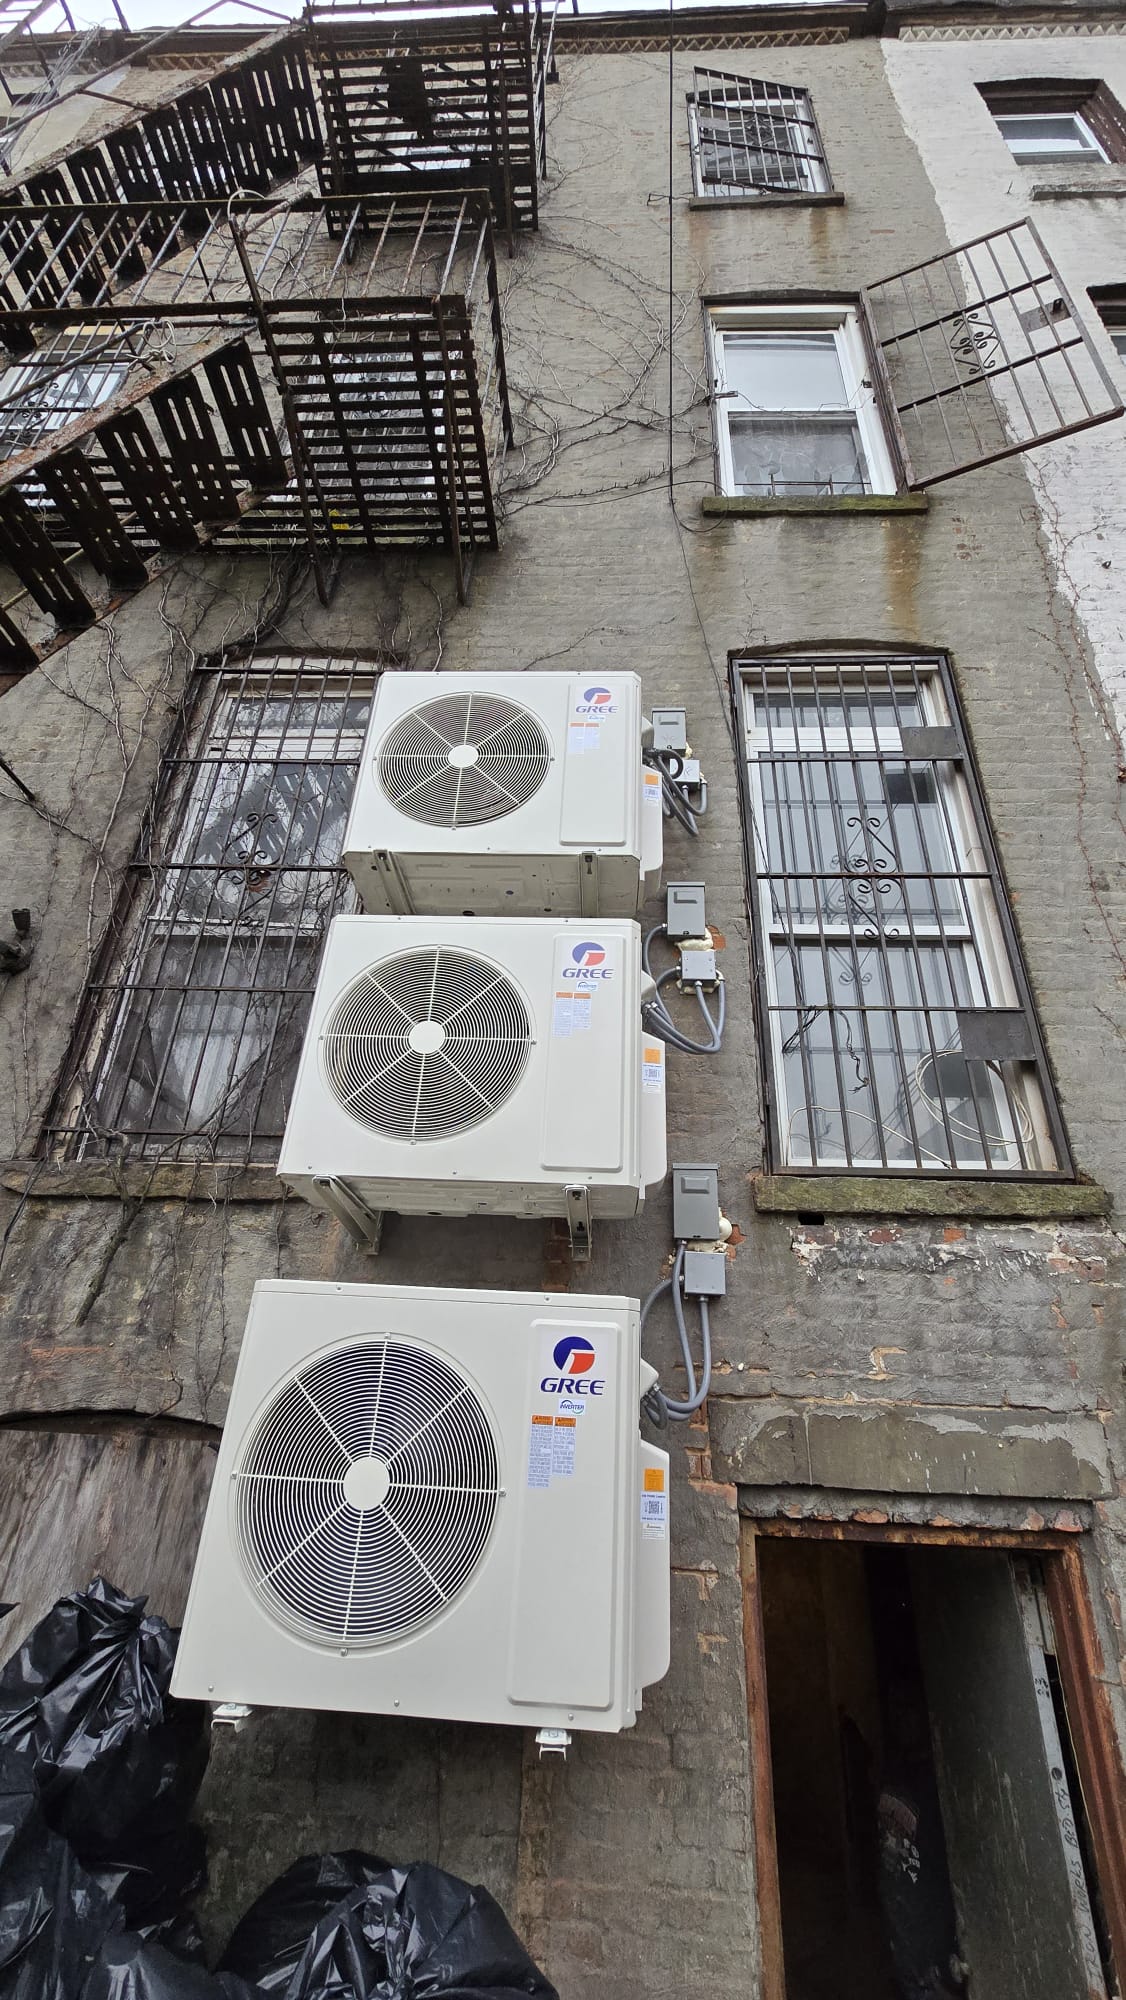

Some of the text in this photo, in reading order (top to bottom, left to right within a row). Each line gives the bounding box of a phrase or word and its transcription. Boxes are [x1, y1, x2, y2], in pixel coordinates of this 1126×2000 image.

[576, 705, 619, 713] GREE
[562, 967, 615, 979] GREE
[540, 1377, 606, 1395] GREE
